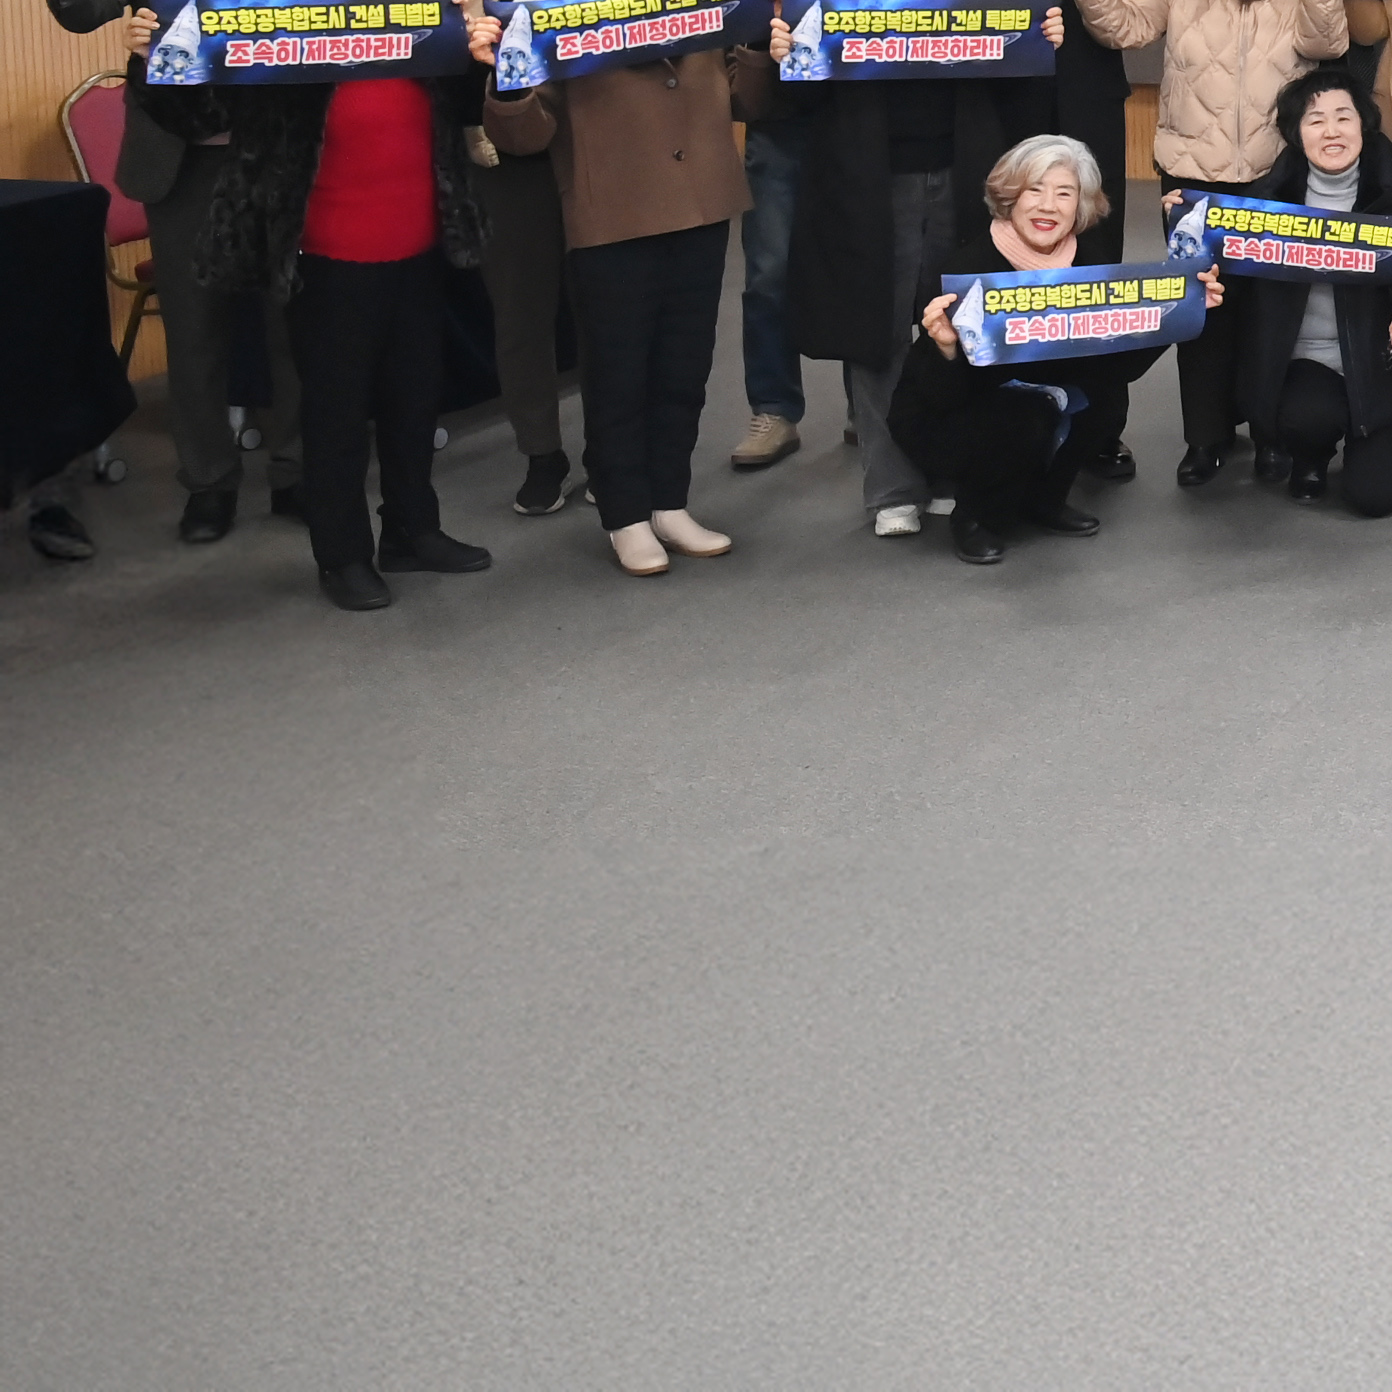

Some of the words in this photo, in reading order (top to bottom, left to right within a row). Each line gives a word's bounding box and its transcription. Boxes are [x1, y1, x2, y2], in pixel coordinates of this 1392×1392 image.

[200, 5, 346, 35] 우주항공복합도시
[349, 4, 386, 29] 건설
[388, 2, 441, 27] 특별법
[556, 26, 626, 60] 조속히
[624, 7, 723, 48] 제정하라!!
[824, 10, 948, 34] 우주항공복합도시
[951, 10, 983, 32] 건설
[986, 9, 1031, 31] 특별법
[225, 38, 301, 66] 조속히
[302, 33, 413, 65] 제정하라!!
[842, 38, 906, 62] 조속히
[906, 36, 1004, 63] 제정하라!!
[1206, 207, 1324, 239] 우주항공복합도시
[1324, 220, 1357, 243] 건설
[1223, 236, 1283, 264] 조속히
[1283, 243, 1376, 272] 제정하라!!
[986, 283, 1107, 313] 우주항공복합도시
[1110, 281, 1139, 304] 건설
[1142, 277, 1186, 301] 특별법
[1006, 314, 1070, 344] 조속히
[1069, 307, 1163, 339] 제정하라!!
